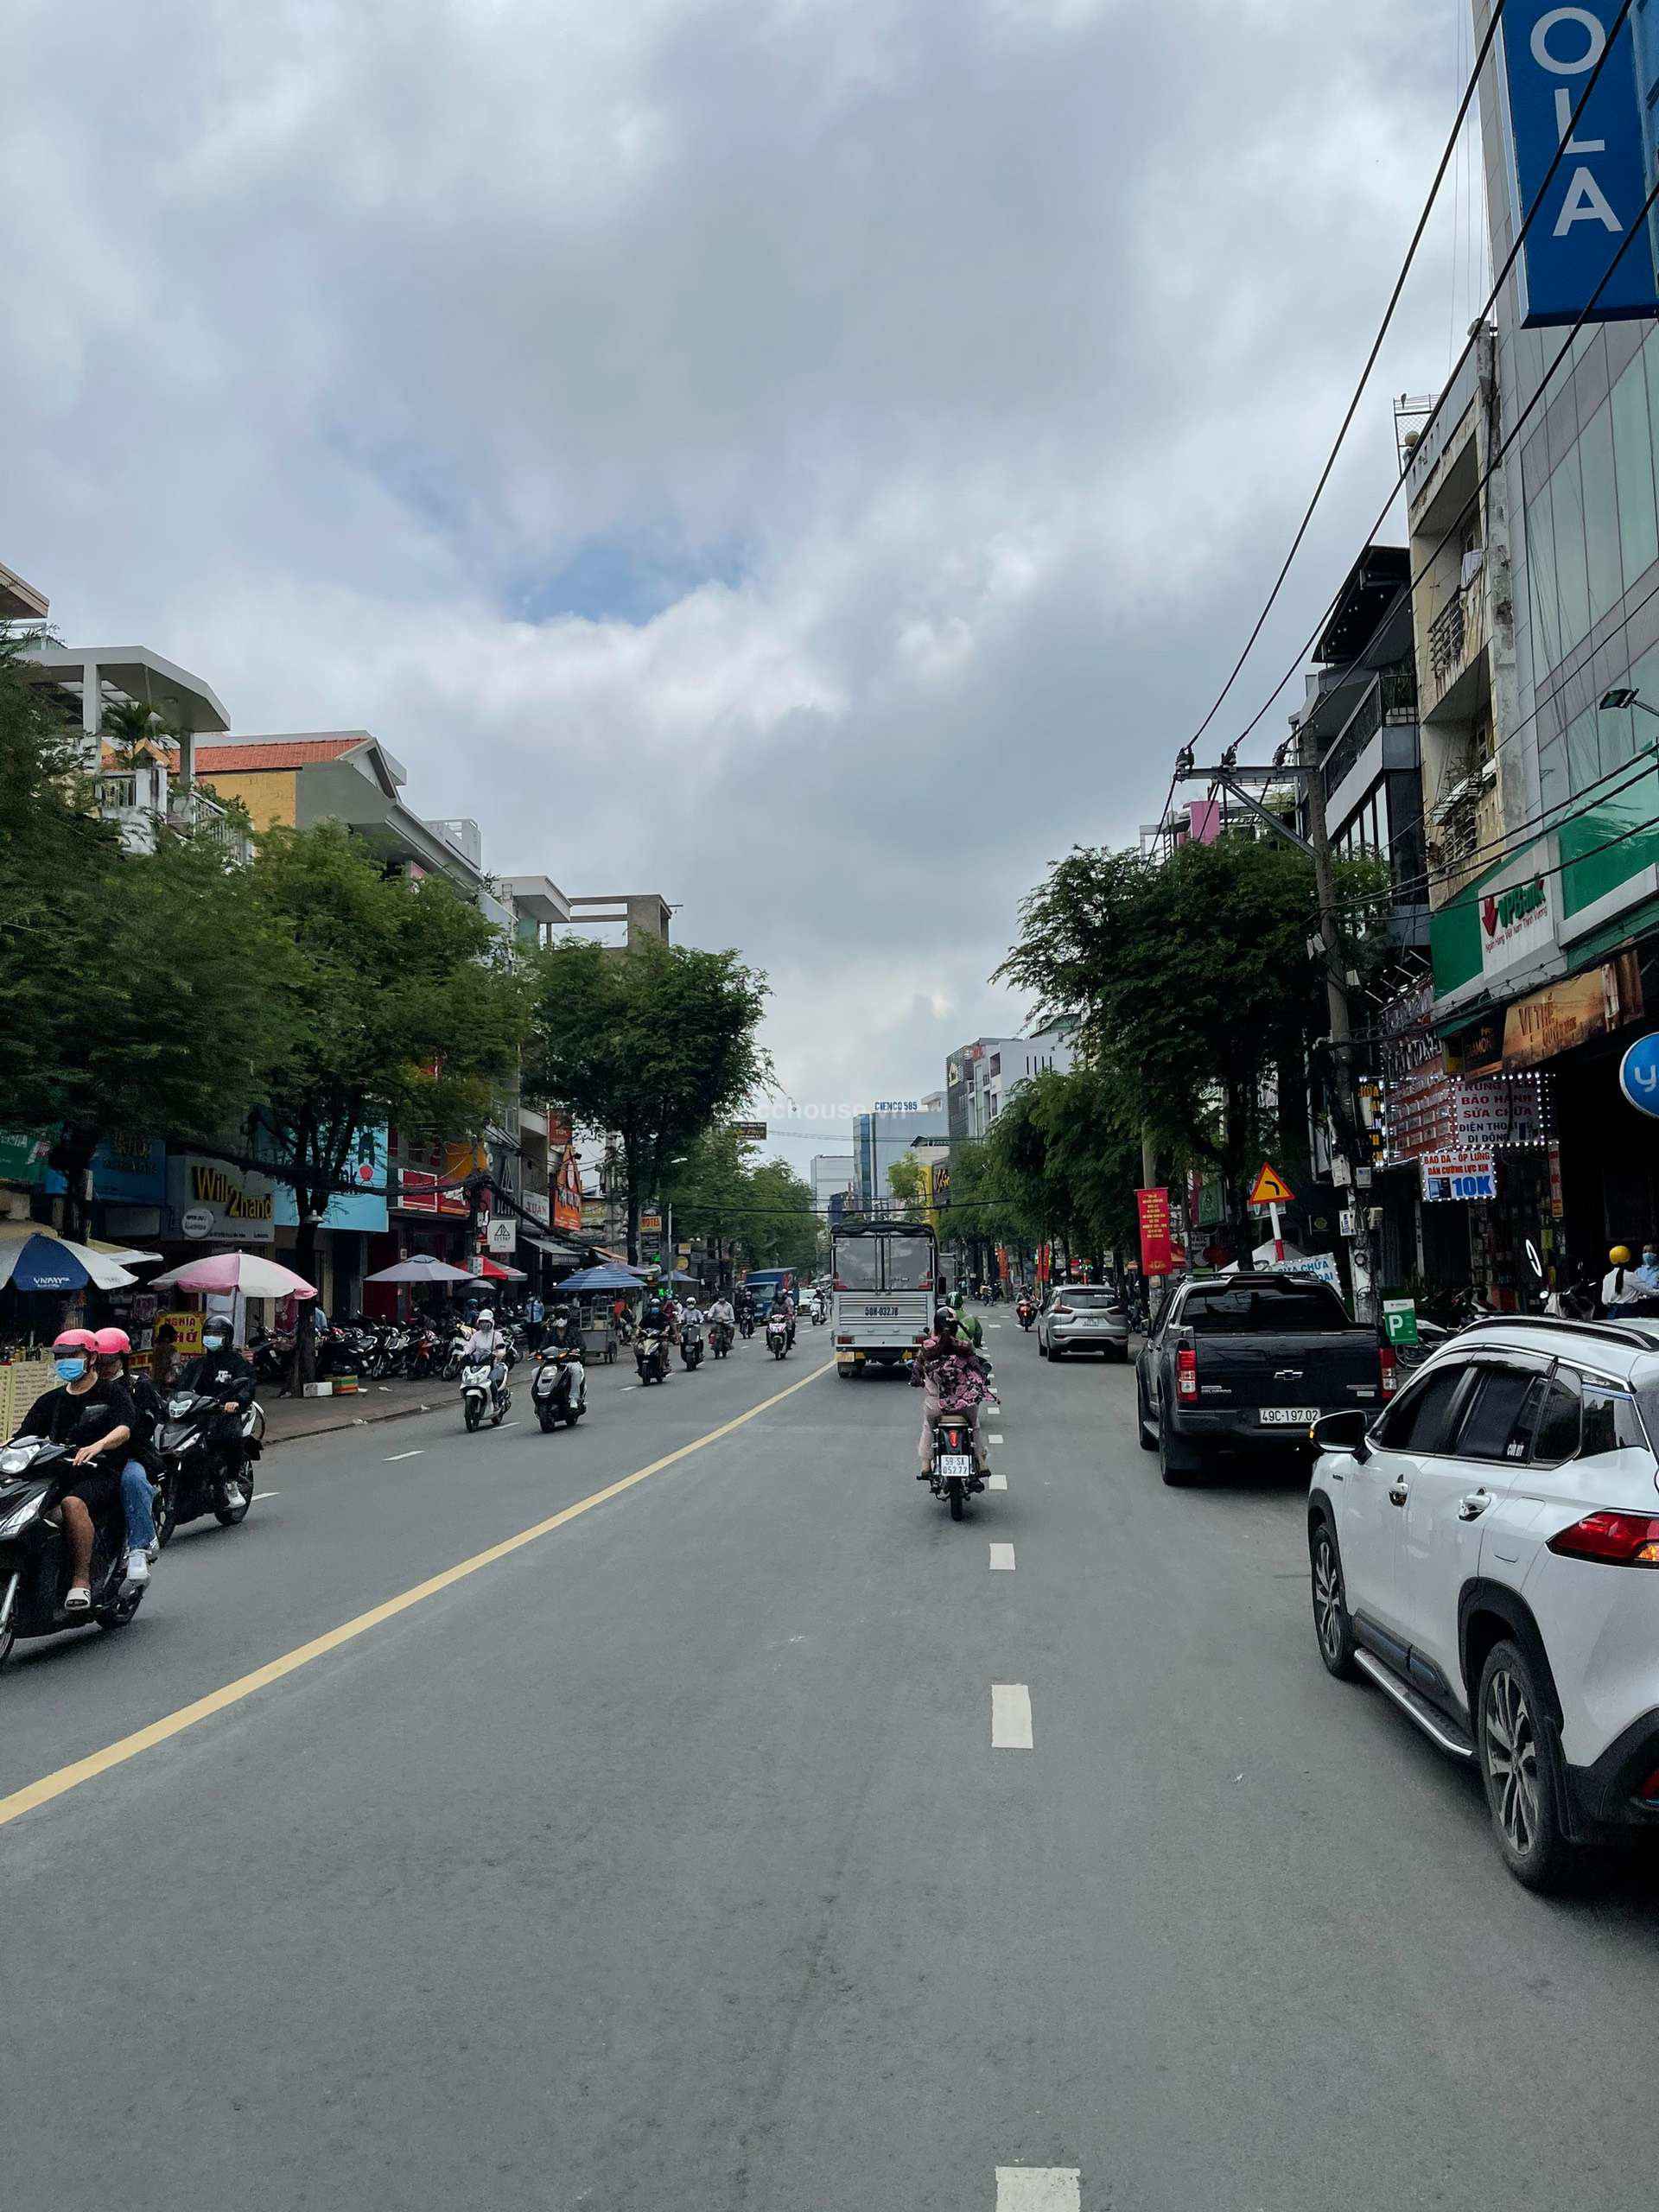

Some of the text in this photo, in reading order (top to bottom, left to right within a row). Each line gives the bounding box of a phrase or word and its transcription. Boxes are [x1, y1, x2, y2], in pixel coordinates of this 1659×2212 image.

[1528, 7, 1624, 237] OLA
[1498, 874, 1546, 928] VPBank
[1461, 1094, 1490, 1105] BẢO
[874, 1101, 918, 1111] CIENCO 585
[1464, 1107, 1491, 1118] SỬA
[1459, 1122, 1484, 1133] ĐIỆN
[1424, 1155, 1439, 1164] BAO
[1441, 1154, 1452, 1163] DA
[1452, 1175, 1492, 1197] 10K
[1389, 1314, 1403, 1337] P
[1262, 1409, 1319, 1422] 49C-197.02
